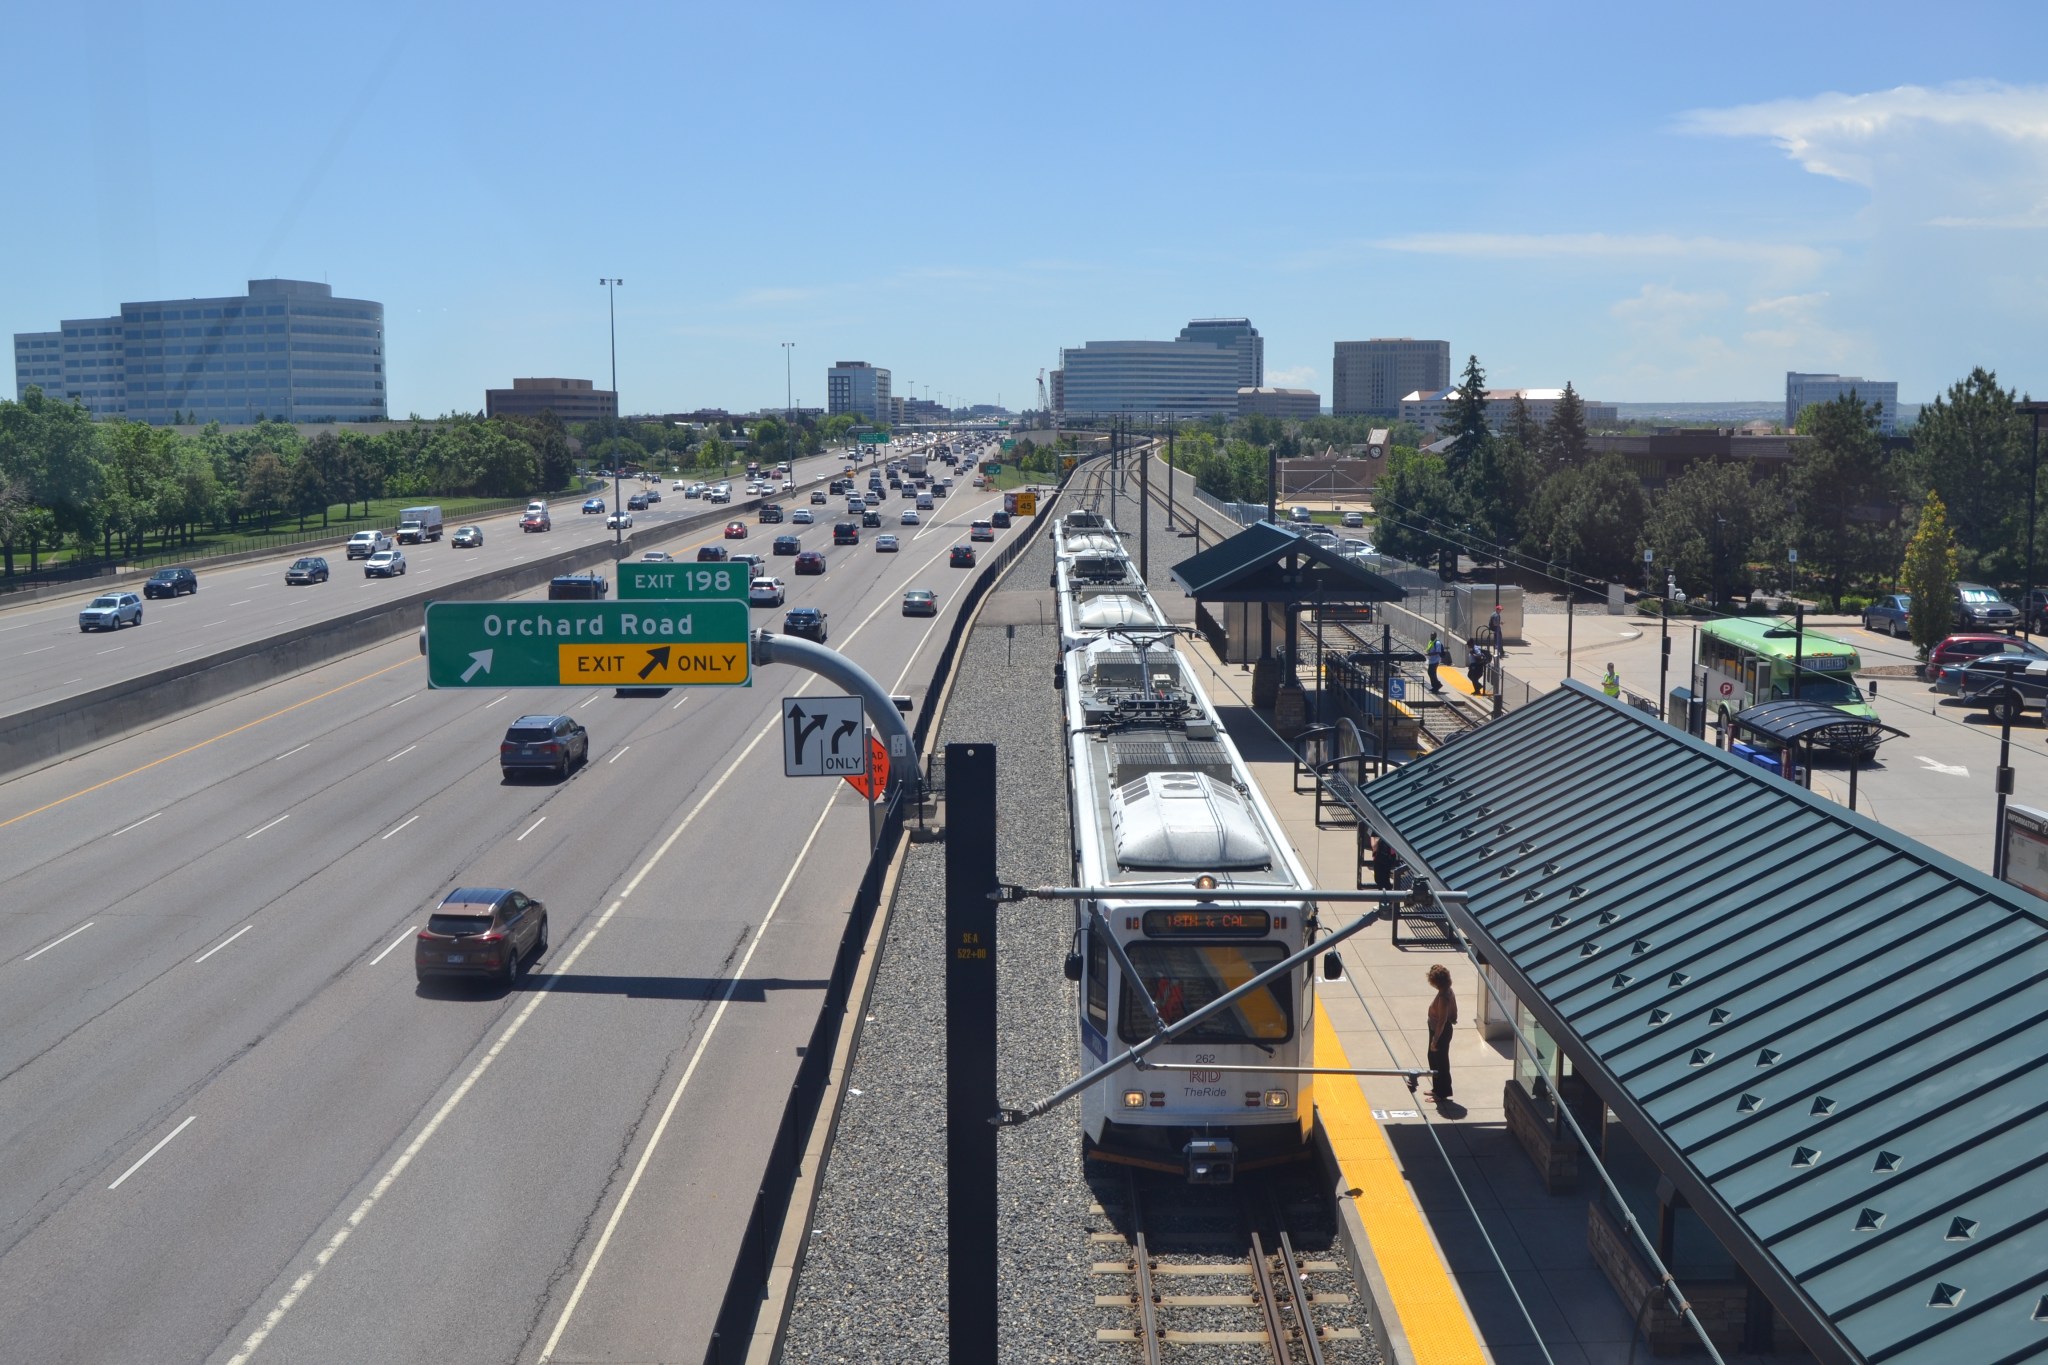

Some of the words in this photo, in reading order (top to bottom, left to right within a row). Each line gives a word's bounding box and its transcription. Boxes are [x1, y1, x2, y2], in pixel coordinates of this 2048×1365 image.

[1020, 502, 1032, 510] 45
[635, 574, 675, 589] EXIT
[685, 571, 731, 591] 198
[484, 614, 603, 636] Orchard
[621, 614, 693, 635] Road
[578, 656, 625, 672] EXIT
[678, 655, 737, 671] ONLY
[825, 757, 861, 770] ONLY
[2007, 813, 2039, 832] INFORMATION
[1205, 915, 1215, 928] &
[1222, 915, 1248, 927] CAL
[1195, 1054, 1216, 1064] 262
[1184, 1087, 1227, 1097] TheRide
